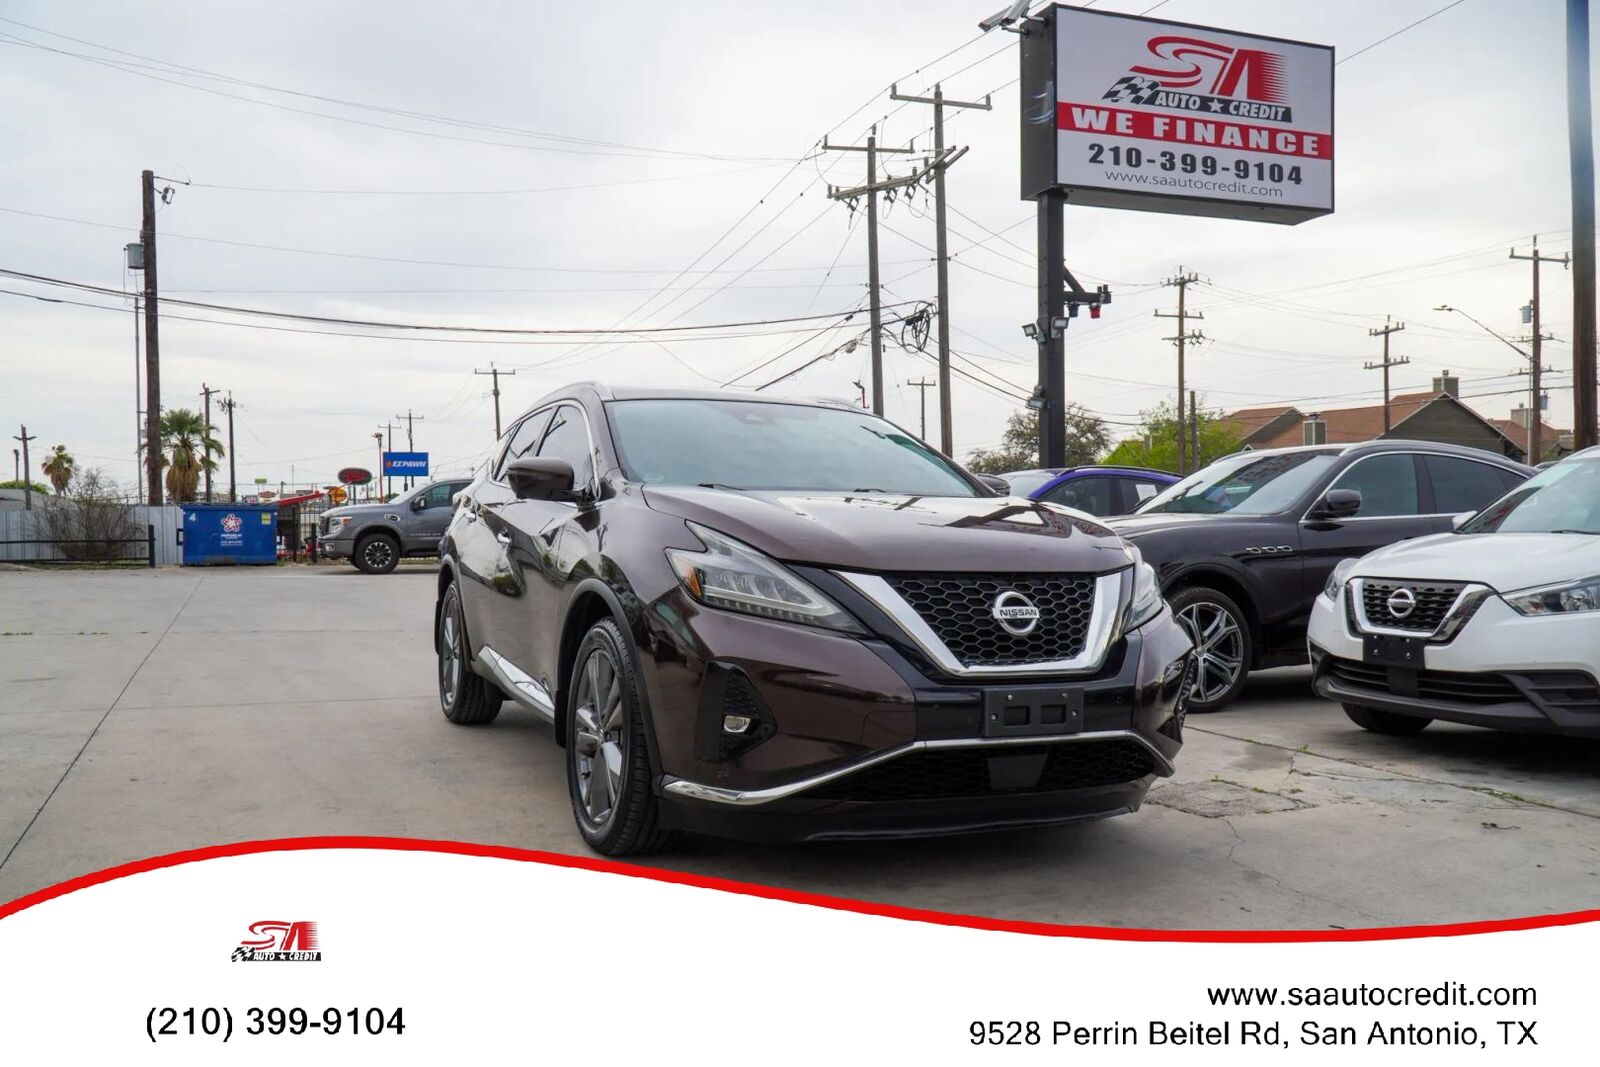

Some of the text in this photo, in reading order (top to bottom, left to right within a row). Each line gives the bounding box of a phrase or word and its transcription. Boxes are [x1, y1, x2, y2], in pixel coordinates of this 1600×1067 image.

[1154, 90, 1287, 121] AUTO CREDIT
[1071, 107, 1320, 156] WE FINANCE
[1088, 143, 1304, 185] 210-399-9104
[1104, 170, 1284, 198] www.saautocredit.com
[999, 608, 1038, 617] NISSAN
